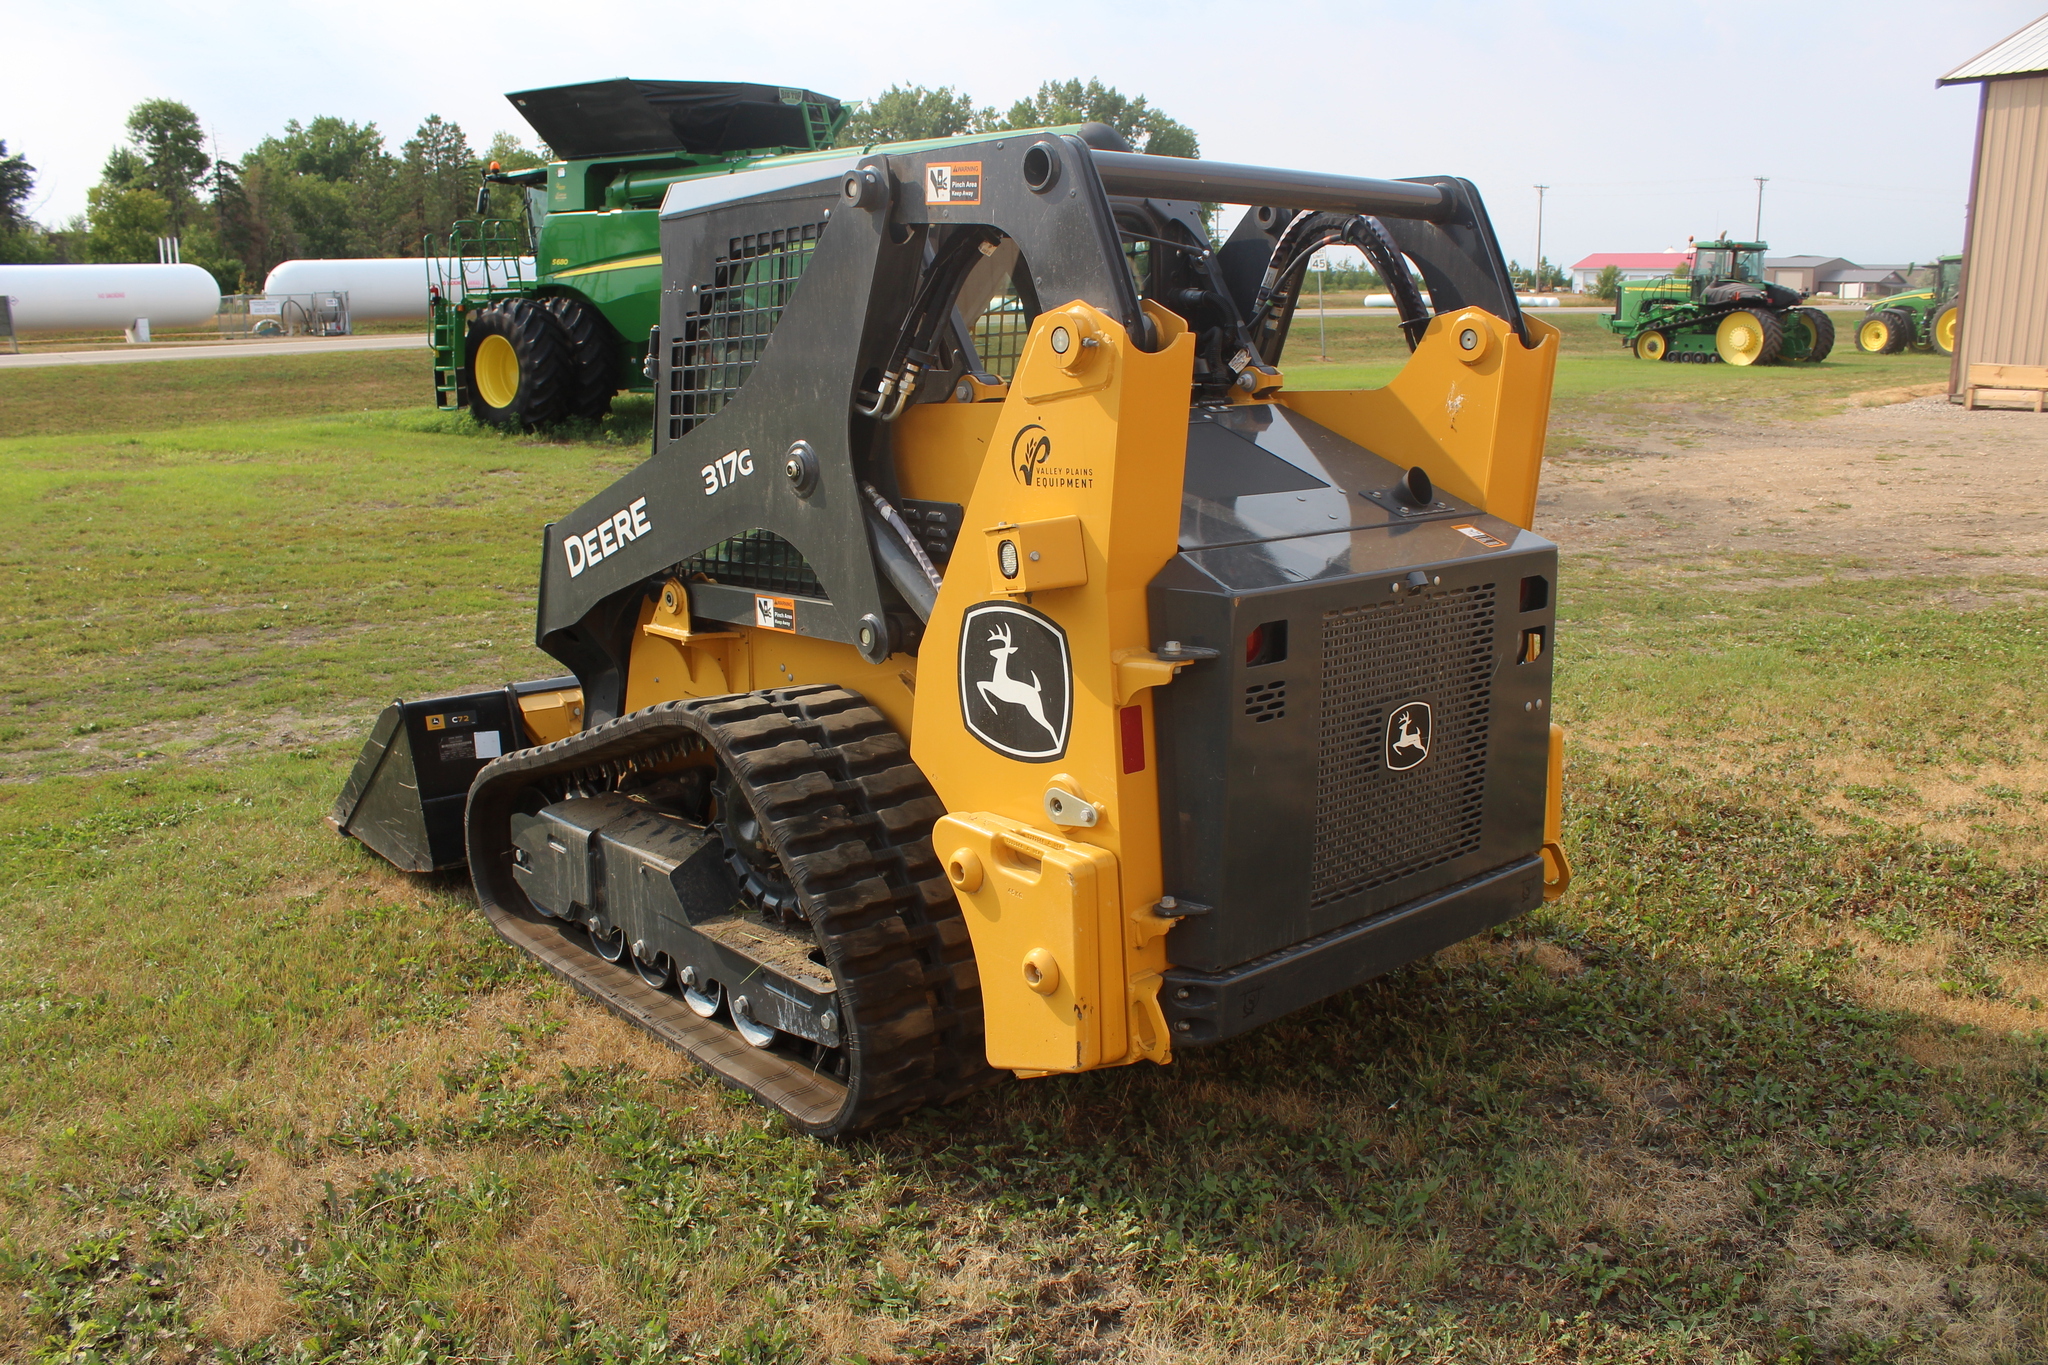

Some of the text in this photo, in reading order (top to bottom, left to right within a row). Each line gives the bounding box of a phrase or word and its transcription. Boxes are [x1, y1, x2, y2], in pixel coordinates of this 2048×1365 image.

[1312, 259, 1325, 268] 45
[701, 448, 754, 496] 317G
[1036, 467, 1093, 476] VALLEY PLAINS
[1036, 477, 1093, 489] EQUIPMENT
[563, 496, 652, 579] DEERE
[451, 715, 469, 723] C72
